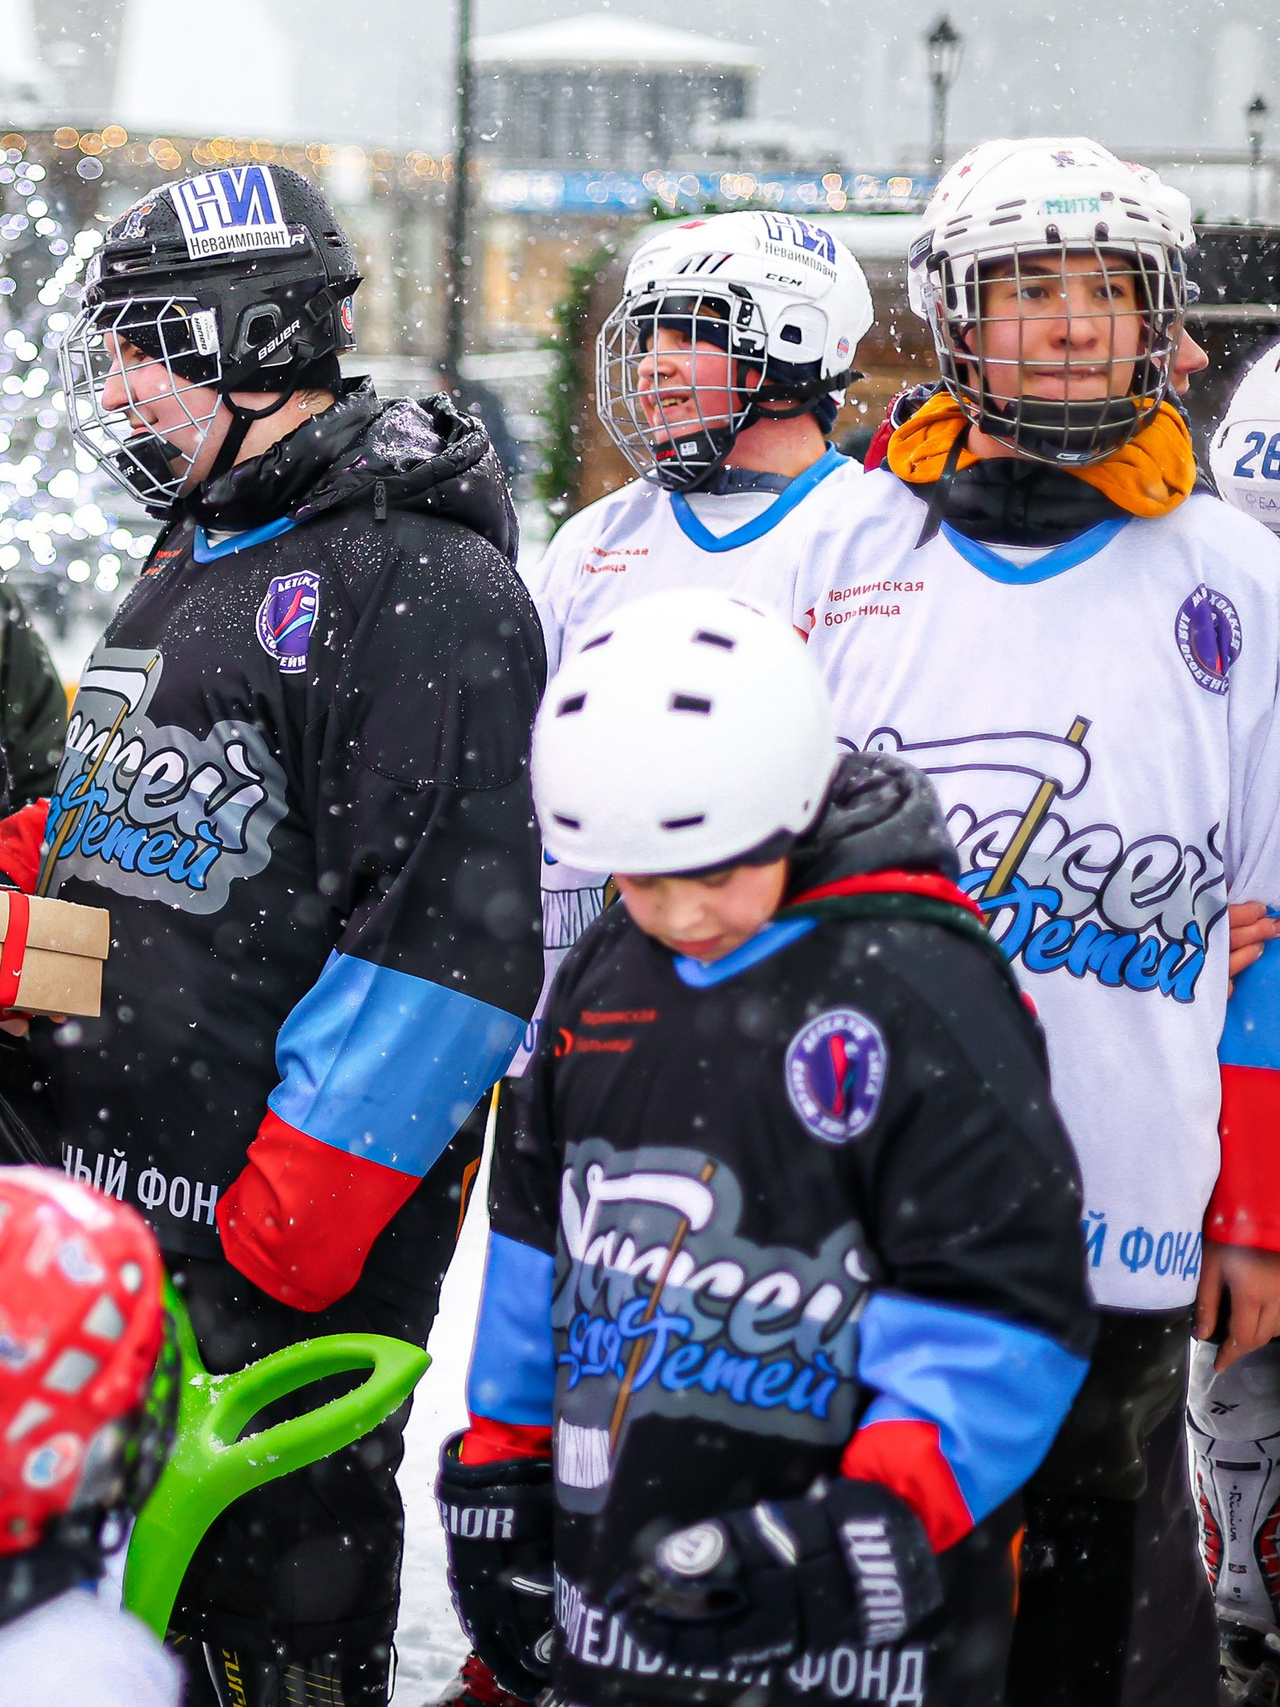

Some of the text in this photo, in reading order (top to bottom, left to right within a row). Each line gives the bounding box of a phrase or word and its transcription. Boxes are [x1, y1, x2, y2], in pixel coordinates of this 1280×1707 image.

[190, 230, 286, 256] Неваимплант
[765, 241, 838, 284] Неваимплант
[766, 272, 803, 286] CCM
[257, 318, 301, 361] BAUER
[136, 1166, 219, 1234] ФОН
